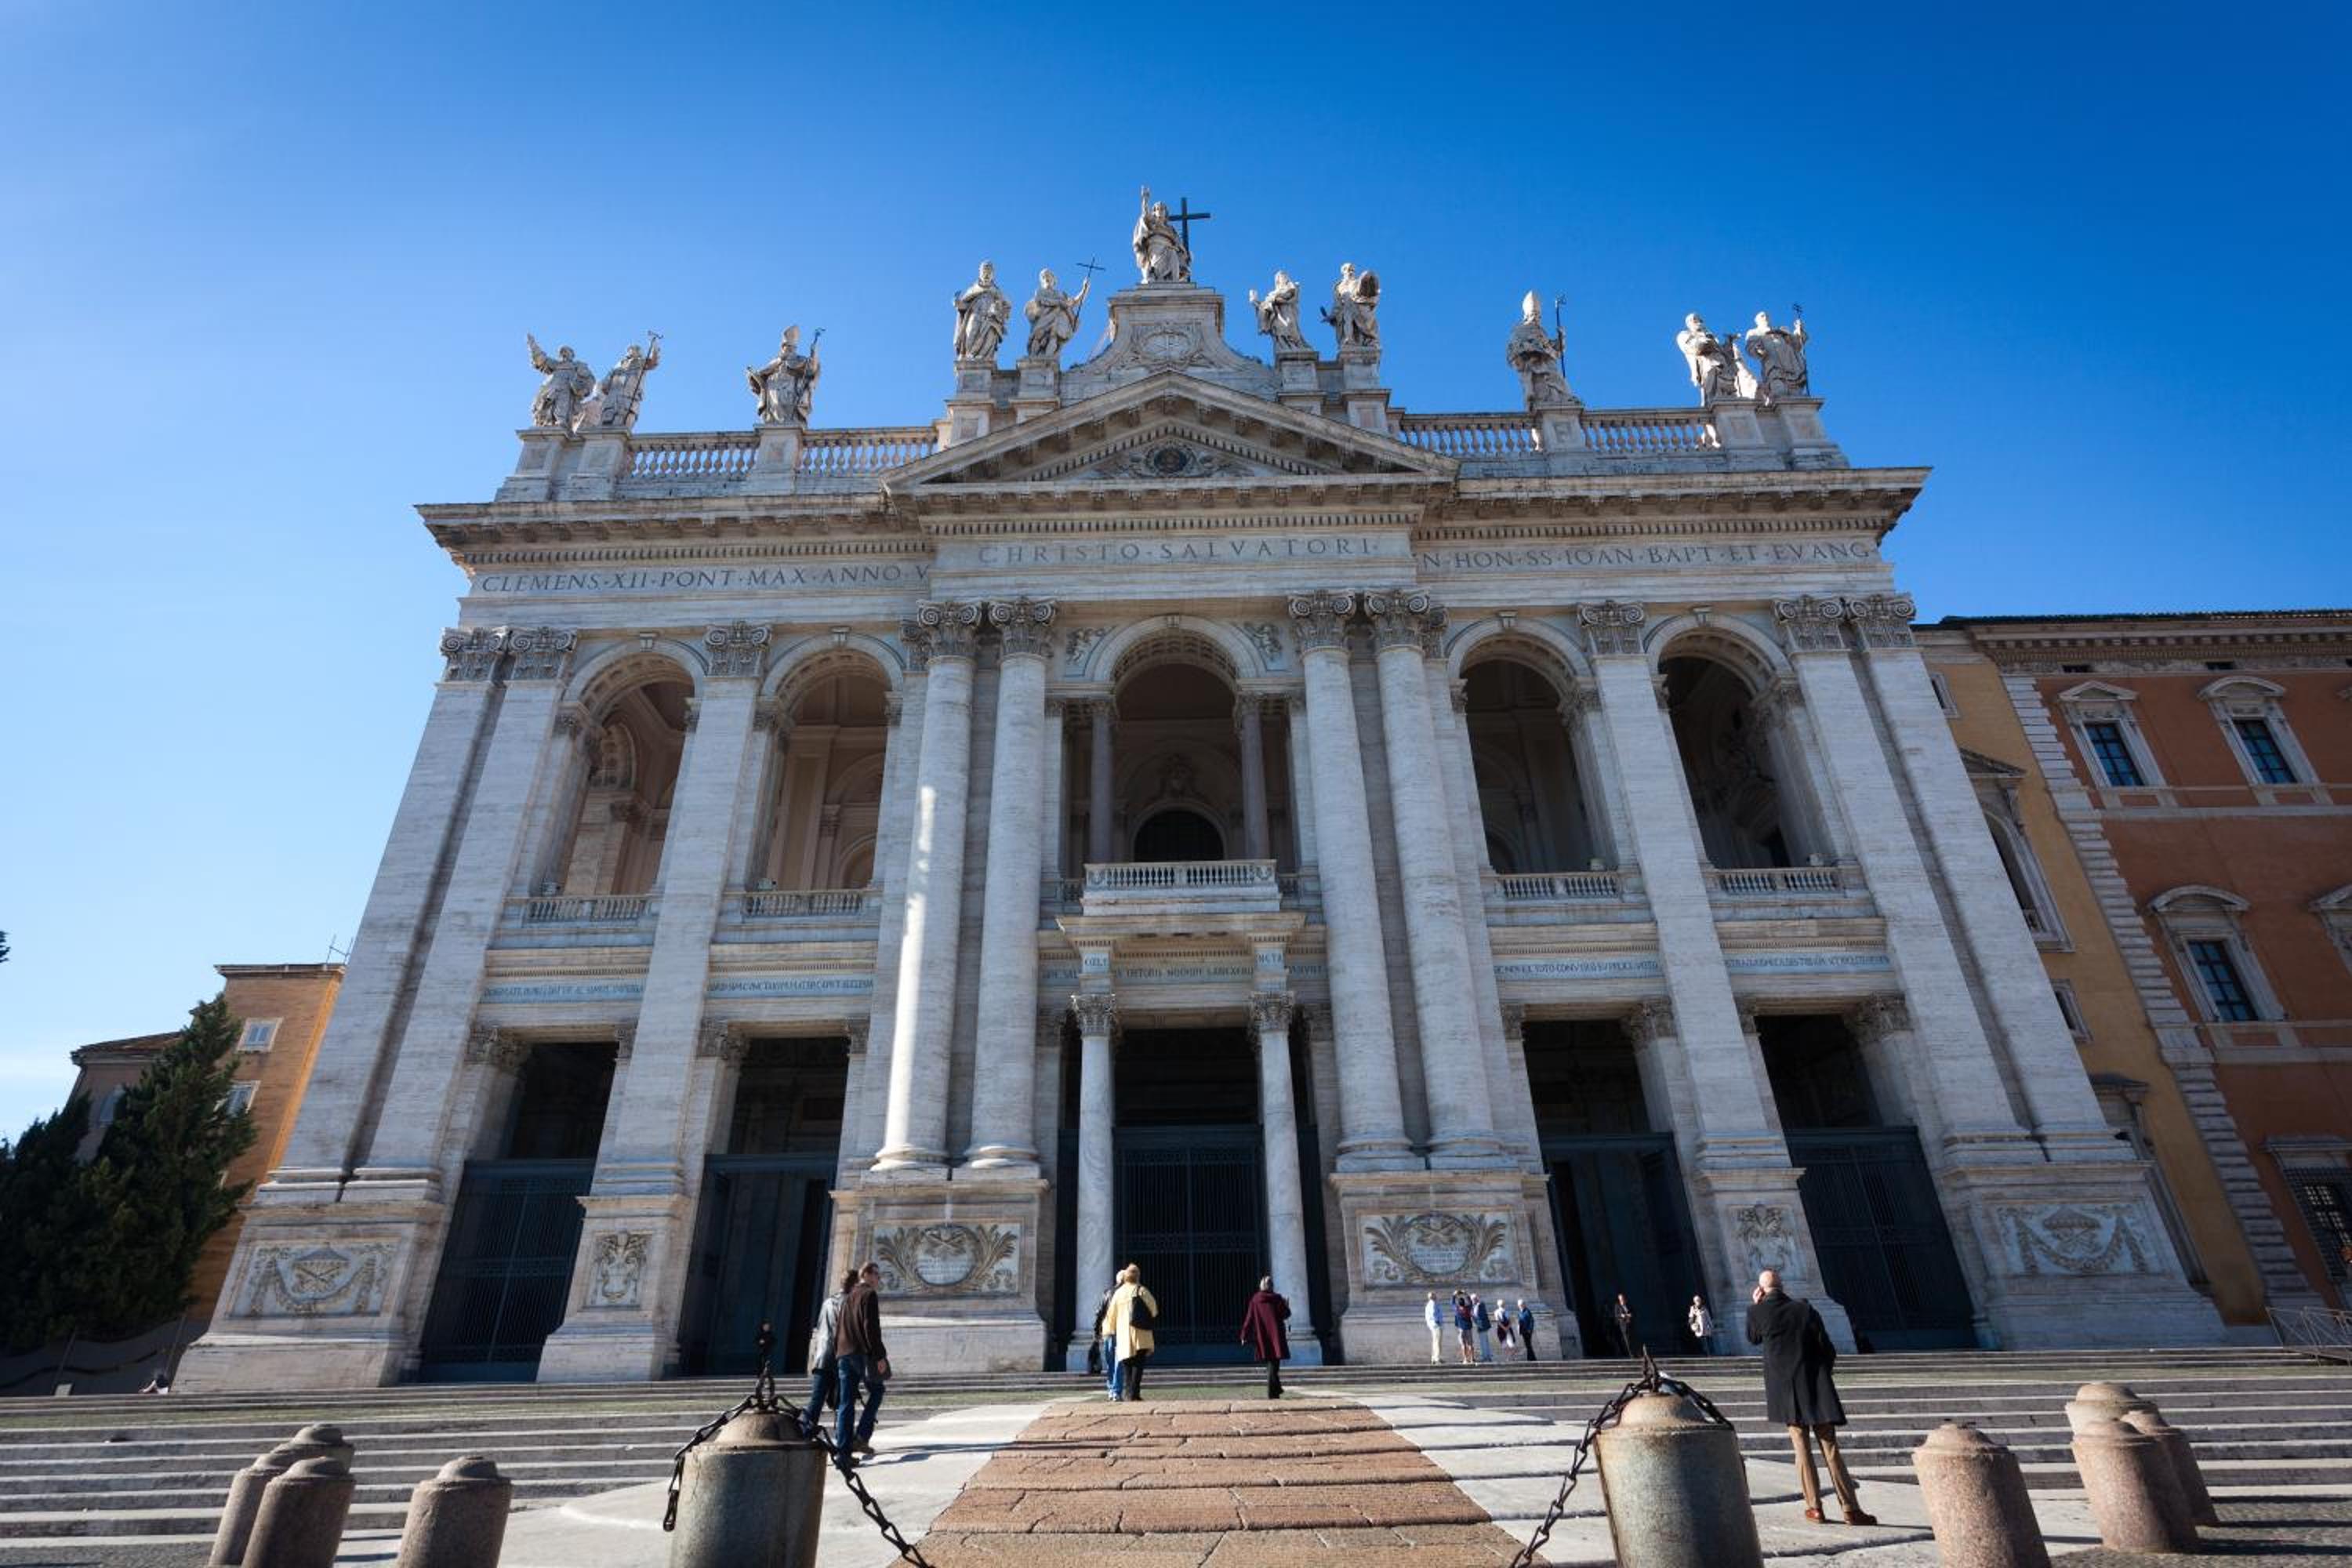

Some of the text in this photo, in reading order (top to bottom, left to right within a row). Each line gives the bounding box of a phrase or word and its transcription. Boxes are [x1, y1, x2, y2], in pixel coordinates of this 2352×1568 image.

[978, 538, 1371, 564] CHRISTO SALVATORI
[1454, 550, 1513, 568] HON
[1526, 550, 1552, 566] SS
[1565, 548, 1633, 565] IOAN
[1647, 546, 1714, 564] BAPT
[1729, 544, 1756, 561] ET
[1772, 541, 1870, 560] EVANG
[482, 572, 601, 592] CLEMENS
[612, 570, 648, 589] XII
[660, 569, 736, 588] PONT
[747, 567, 807, 586] MAX
[822, 564, 901, 583] ANNO
